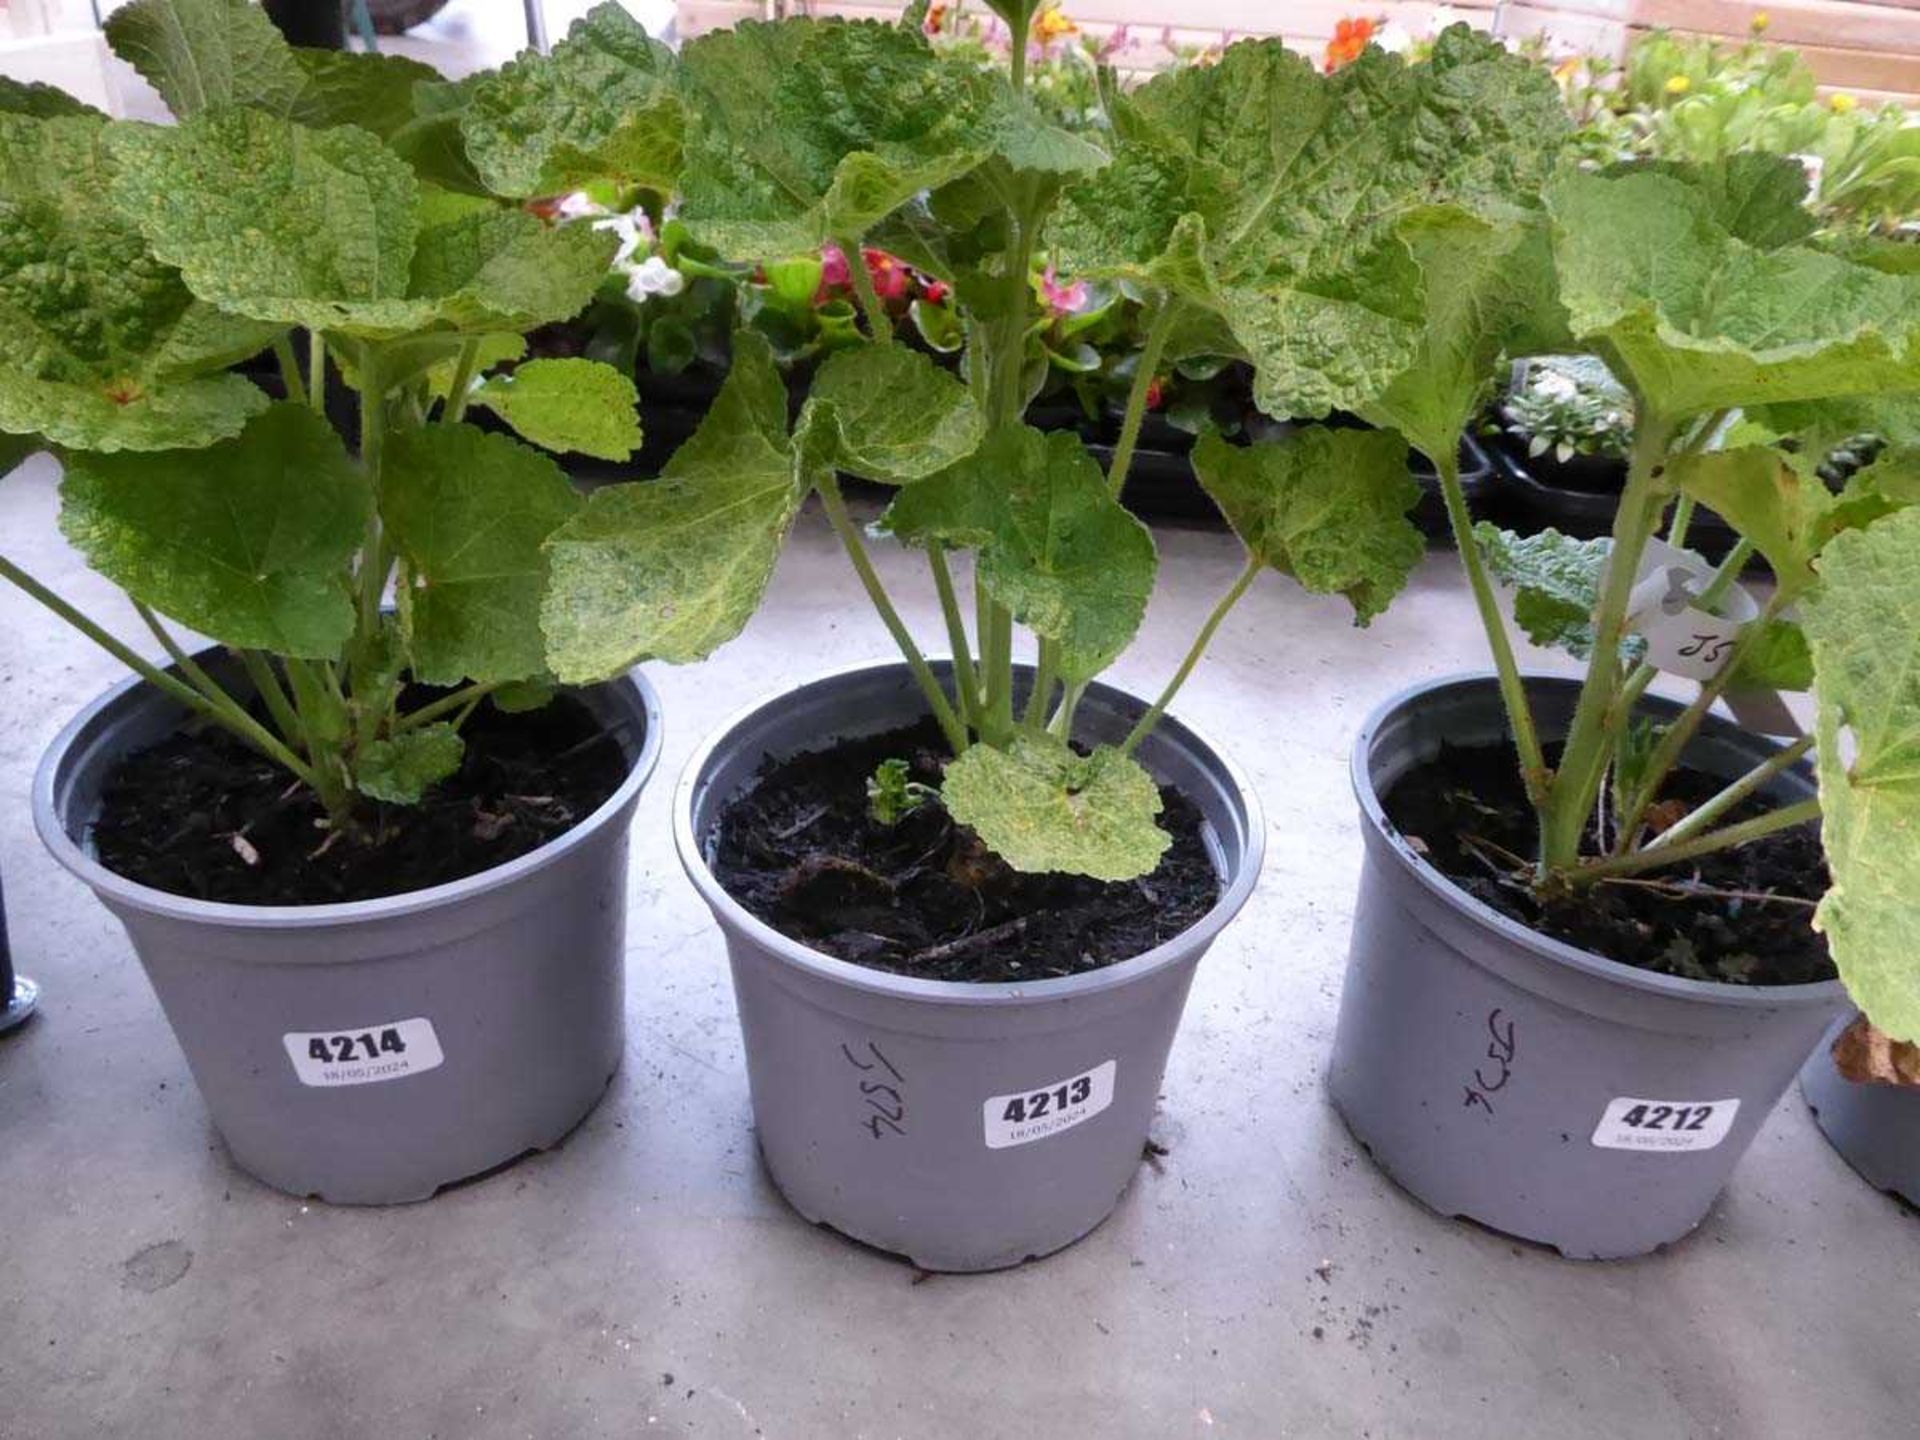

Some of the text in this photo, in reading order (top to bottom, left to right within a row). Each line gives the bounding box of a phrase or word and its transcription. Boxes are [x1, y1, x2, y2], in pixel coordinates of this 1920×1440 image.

[308, 1028, 406, 1063] 4214
[1002, 1076, 1091, 1123] 4213
[1621, 1104, 1713, 1131] 4212
